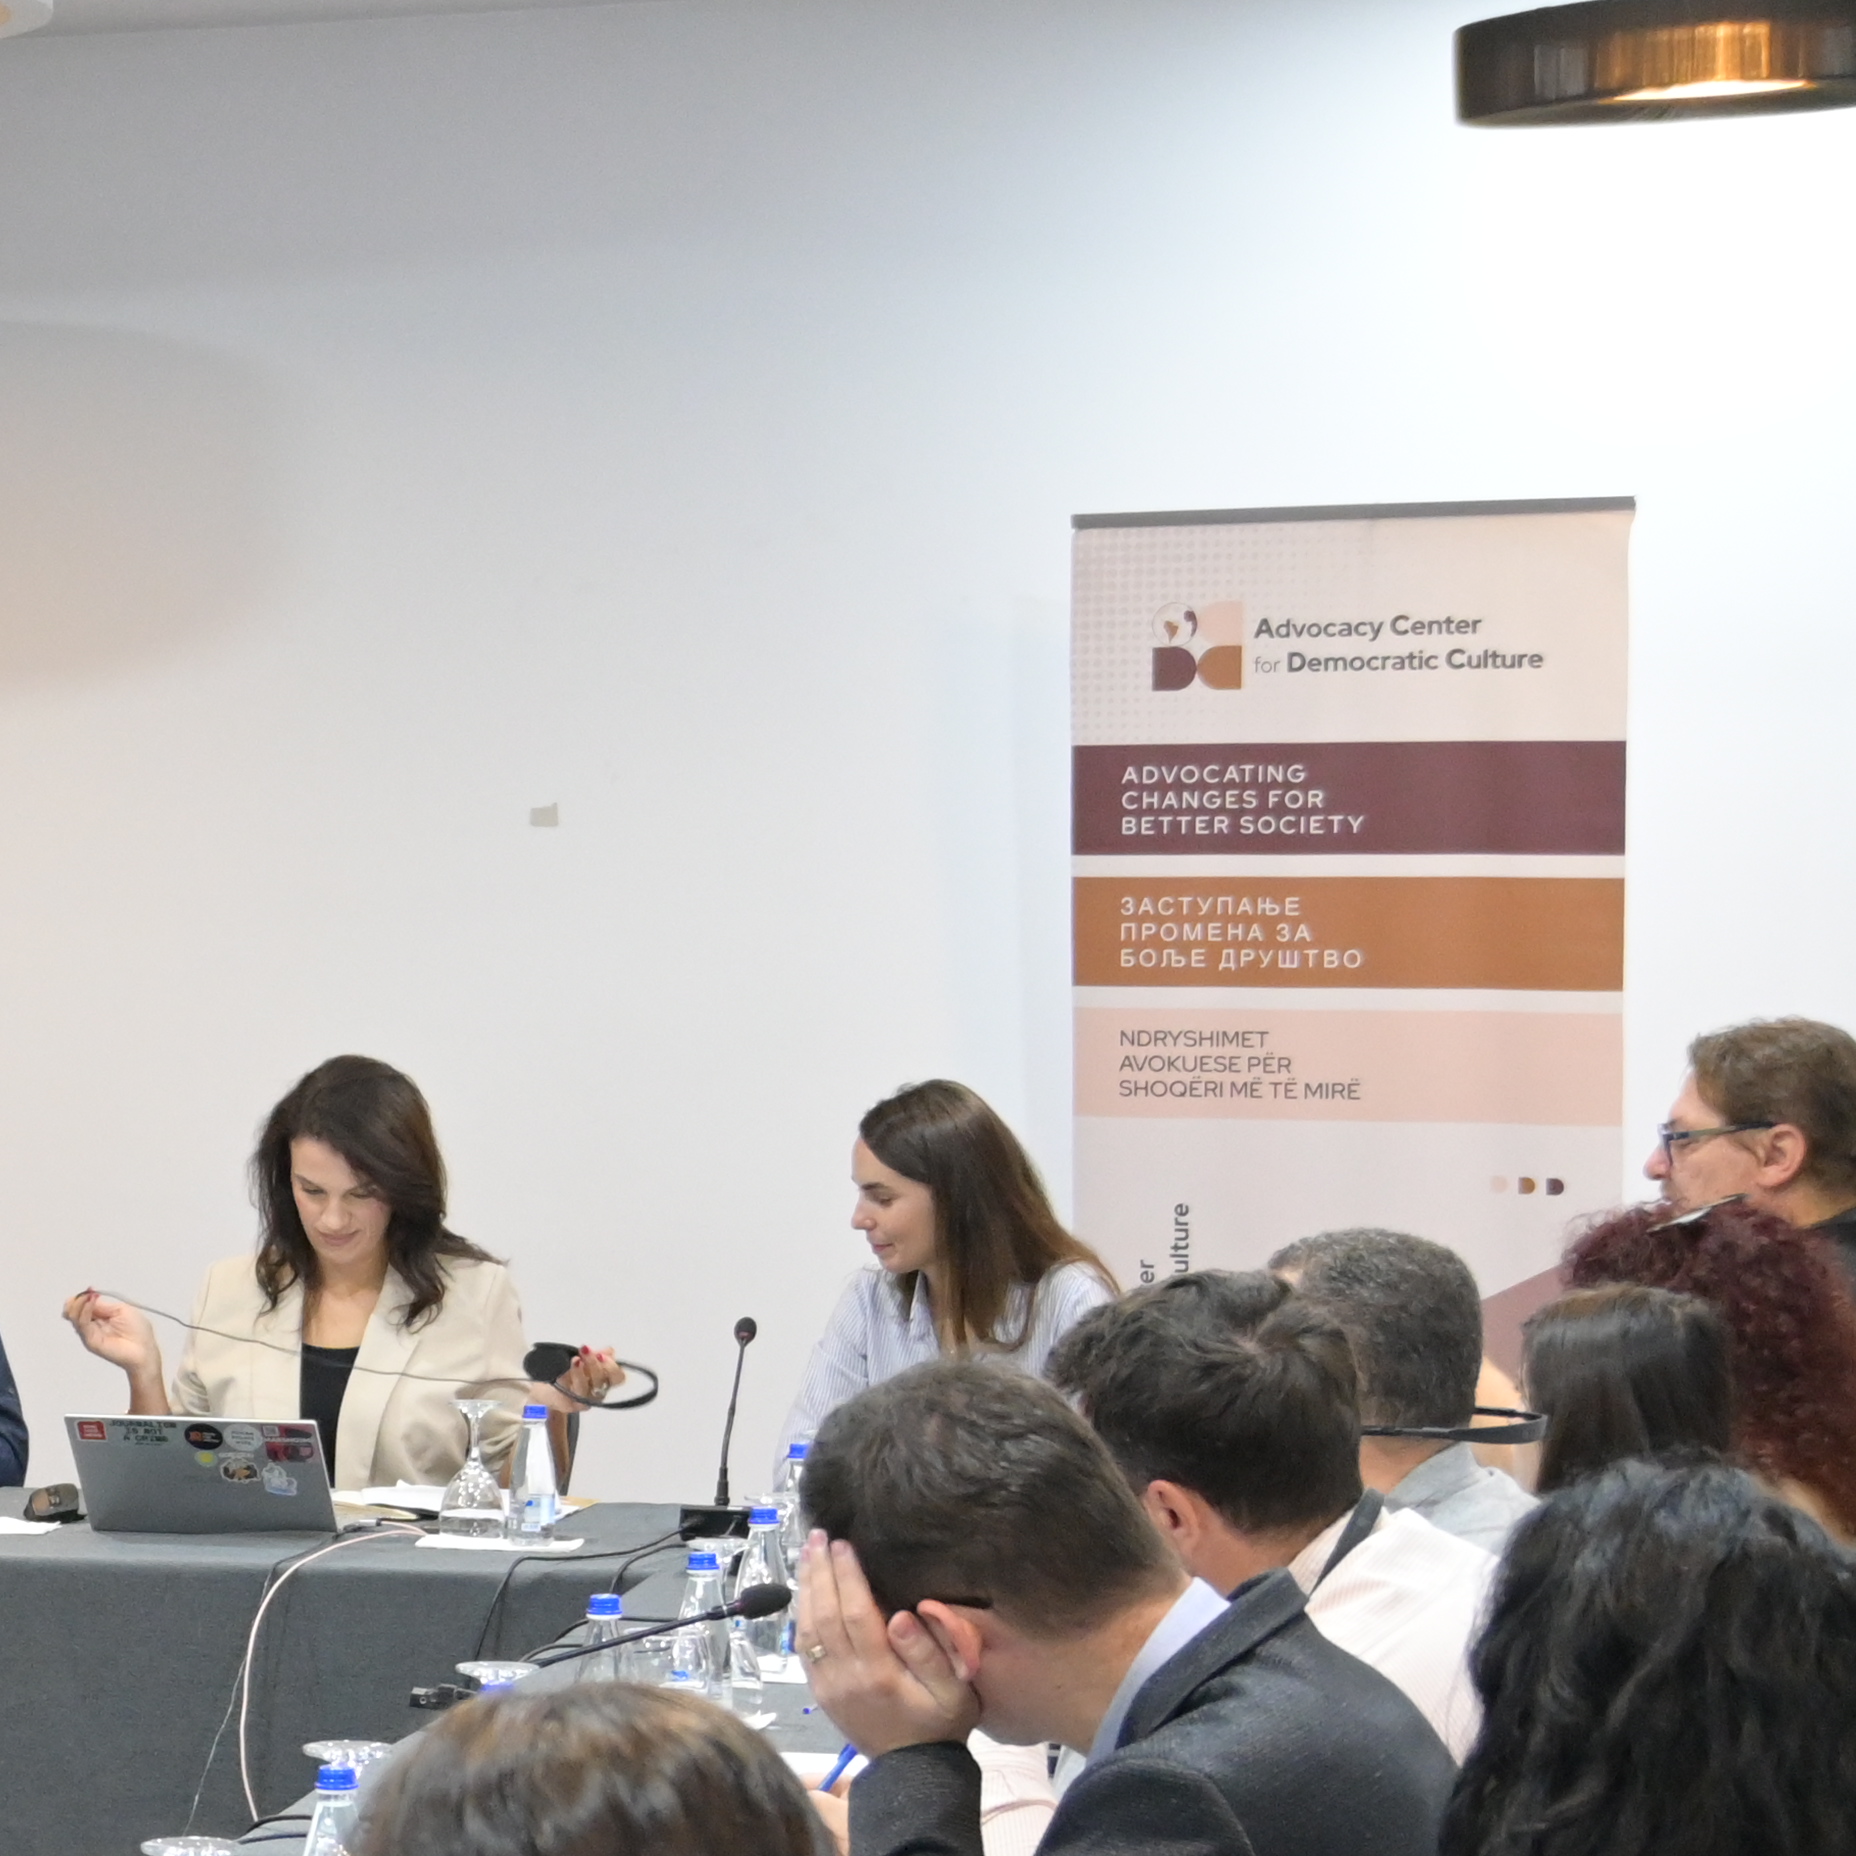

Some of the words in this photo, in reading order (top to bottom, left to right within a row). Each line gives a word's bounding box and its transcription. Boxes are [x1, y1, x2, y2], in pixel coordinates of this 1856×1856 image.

[1254, 617, 1384, 642] Advocacy
[1389, 614, 1483, 636] Center
[1254, 655, 1281, 674] for
[1287, 649, 1439, 673] Democratic
[1445, 648, 1544, 670] Culture
[1121, 764, 1306, 784] ADVOCATING
[1121, 789, 1257, 810] CHANGES
[1268, 789, 1324, 809] FOR
[1121, 815, 1229, 835] BETTER
[1240, 814, 1364, 835] SOCIETY
[1120, 896, 1300, 916] ЗАСТУПАЊЕ
[1120, 922, 1263, 942] ПРОМЕНА
[1276, 922, 1312, 943] ЗА
[1120, 948, 1206, 968] БОЉЕ
[1218, 948, 1362, 971] ДРУШТВО
[1120, 1029, 1270, 1049] NDRYSHIMET
[1119, 1054, 1242, 1074] AVOKUESE
[1247, 1051, 1292, 1074] PËR
[1119, 1076, 1224, 1098] SHOQËRI
[1230, 1076, 1263, 1099] MË
[1269, 1077, 1298, 1100] TË
[1304, 1078, 1361, 1101] MIRË
[1169, 1202, 1190, 1274] ulture
